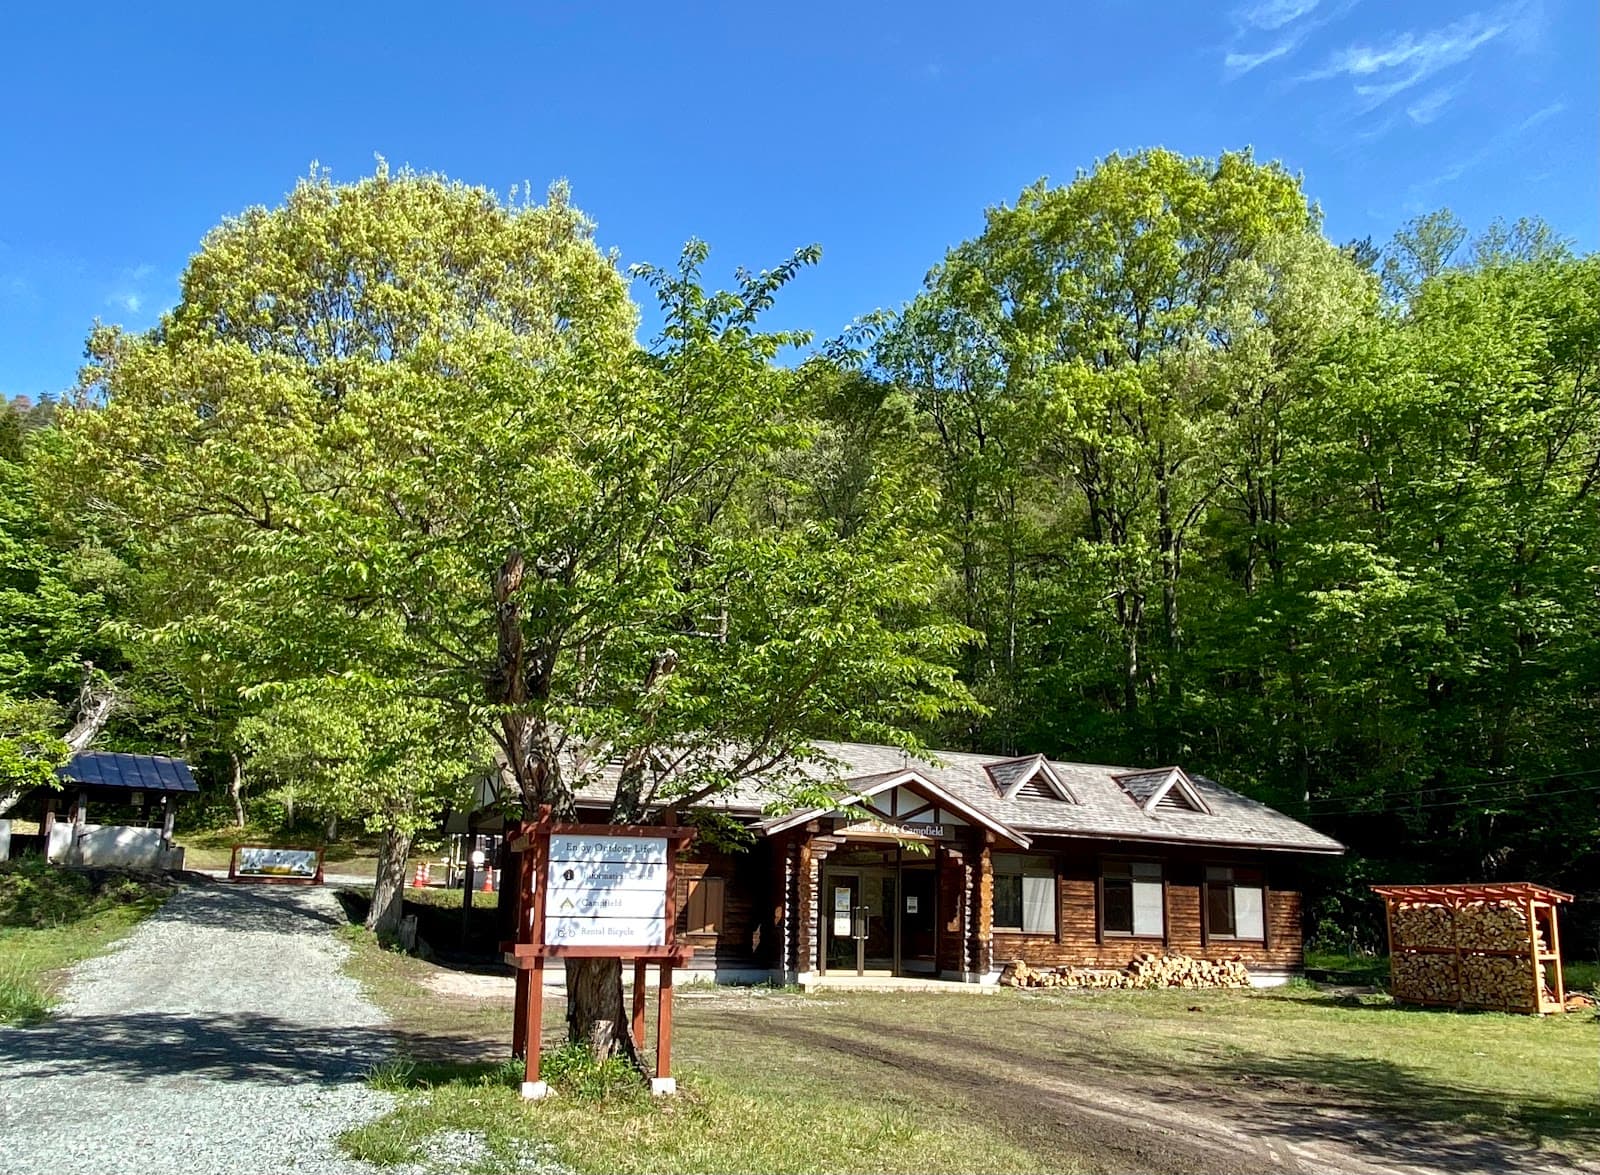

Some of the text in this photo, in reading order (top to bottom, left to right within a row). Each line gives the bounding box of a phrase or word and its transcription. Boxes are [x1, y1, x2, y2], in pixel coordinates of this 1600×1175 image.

[901, 824, 944, 837] Campfield
[566, 842, 591, 854] Enoy
[635, 844, 653, 855] Life
[582, 898, 622, 910] Campfield
[581, 927, 634, 938] Rental Bicycle
